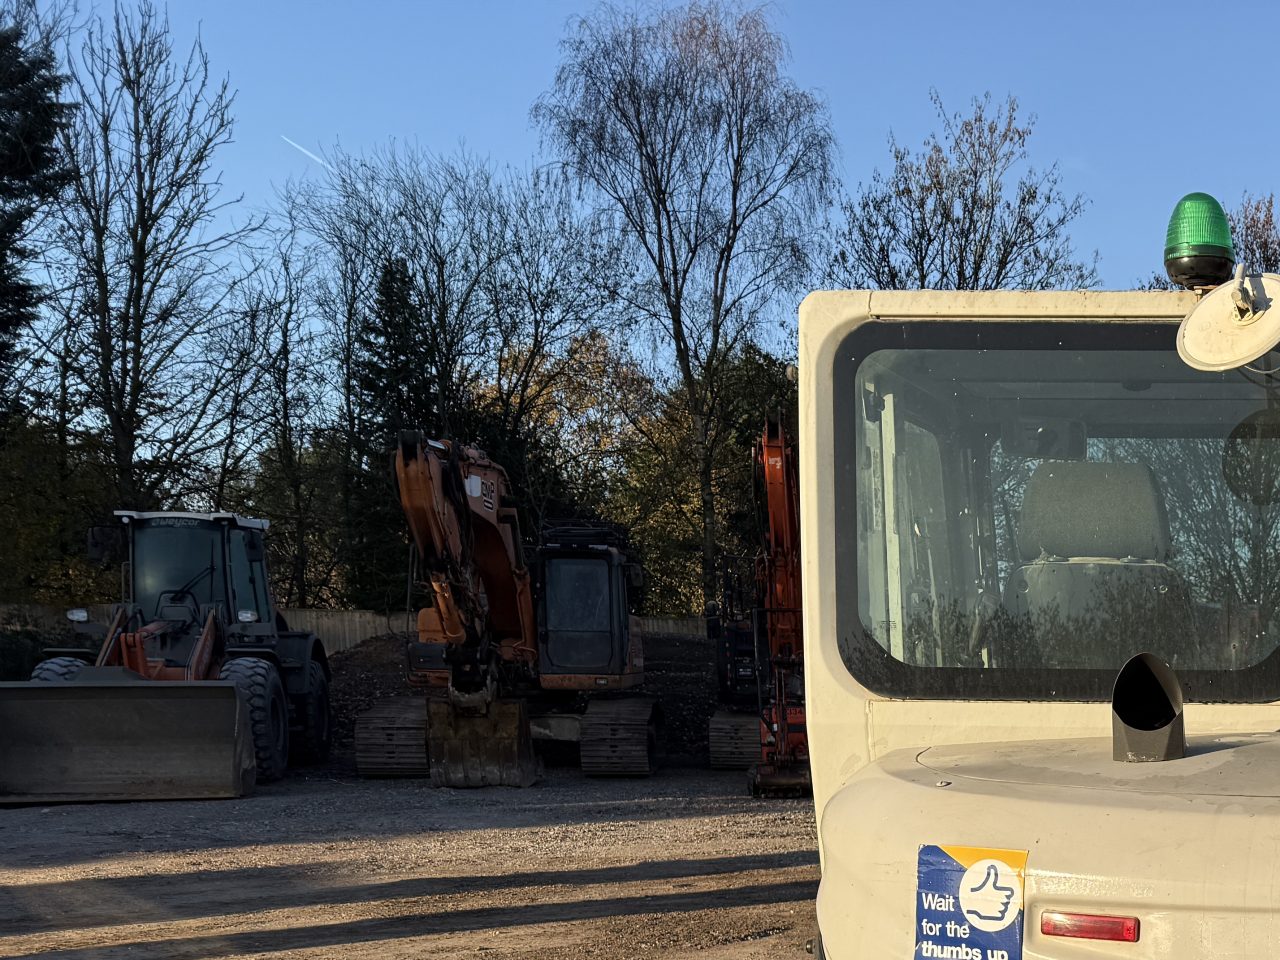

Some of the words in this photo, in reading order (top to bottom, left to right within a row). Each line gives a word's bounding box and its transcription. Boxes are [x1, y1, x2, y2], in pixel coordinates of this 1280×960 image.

[922, 893, 954, 911] Wait
[922, 921, 942, 936] for
[946, 922, 970, 938] the
